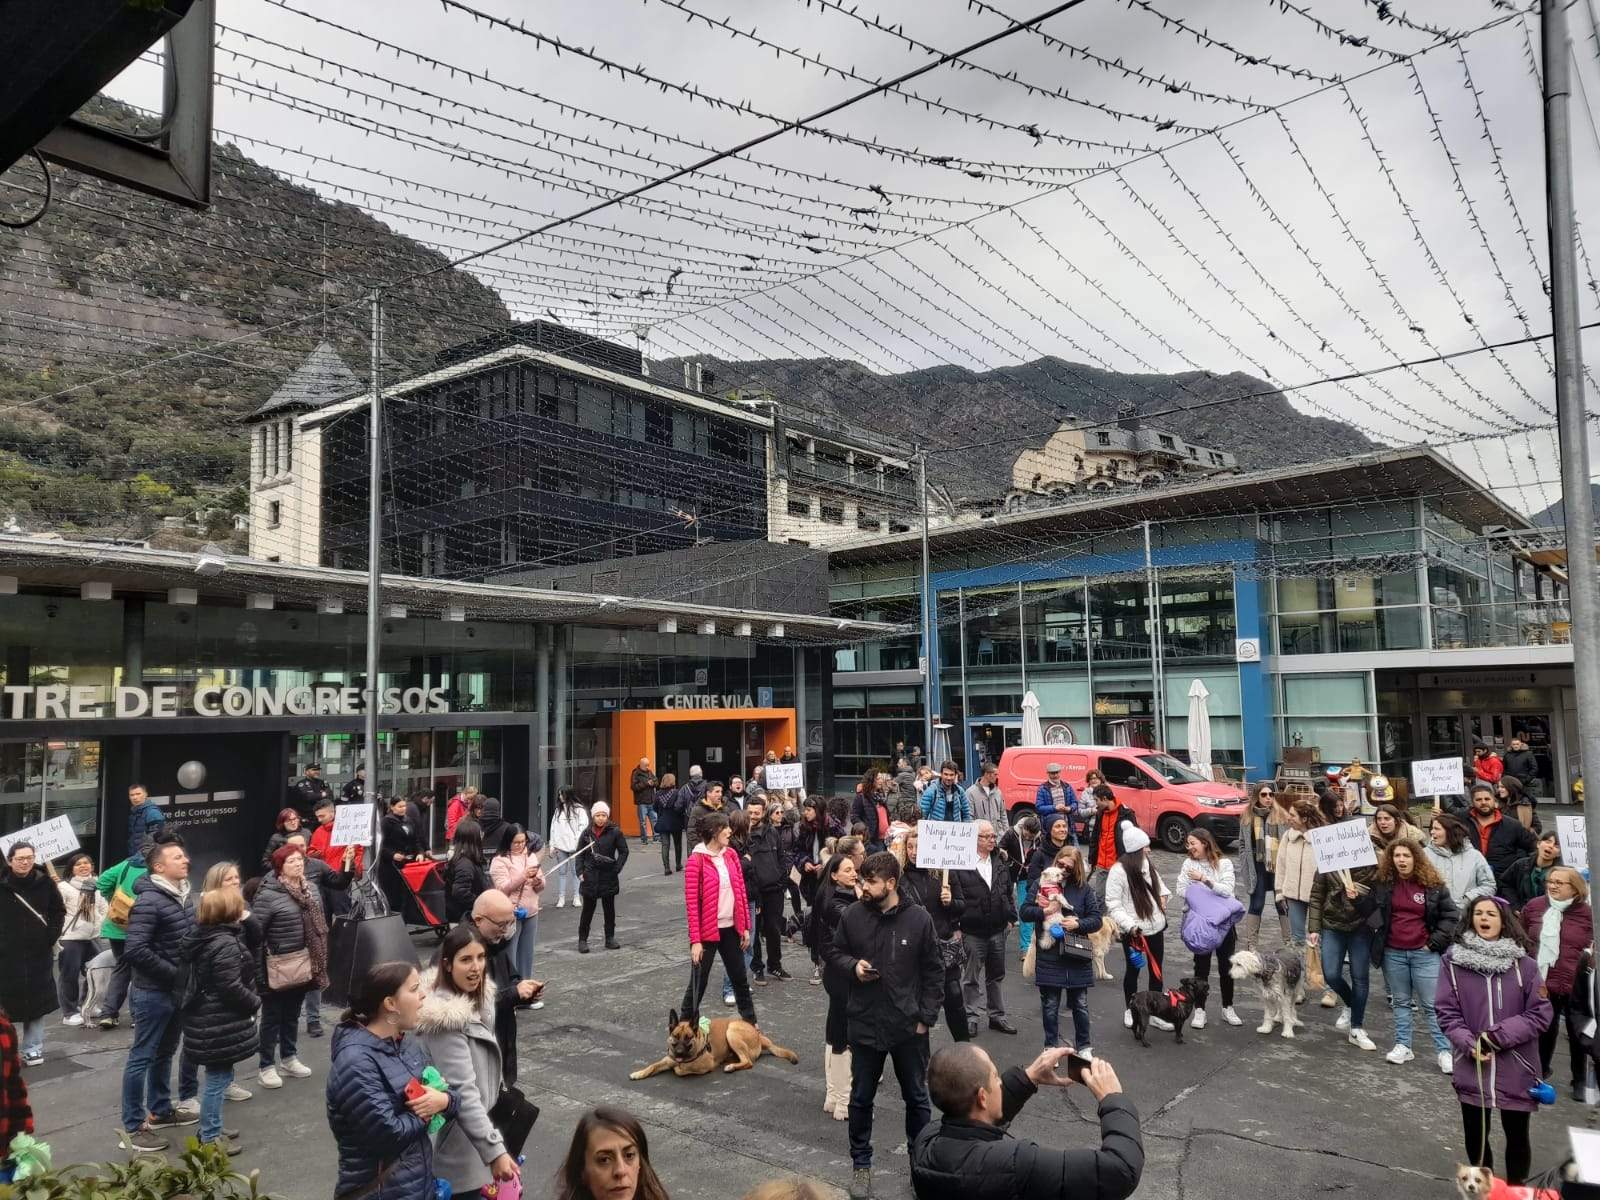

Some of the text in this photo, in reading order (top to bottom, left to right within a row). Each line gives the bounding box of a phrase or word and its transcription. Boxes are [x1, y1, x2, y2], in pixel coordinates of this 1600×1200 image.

[115, 686, 177, 717] DE
[663, 694, 753, 710] CENTRE VILA
[188, 806, 237, 818] Congressos
[923, 856, 936, 865] una
